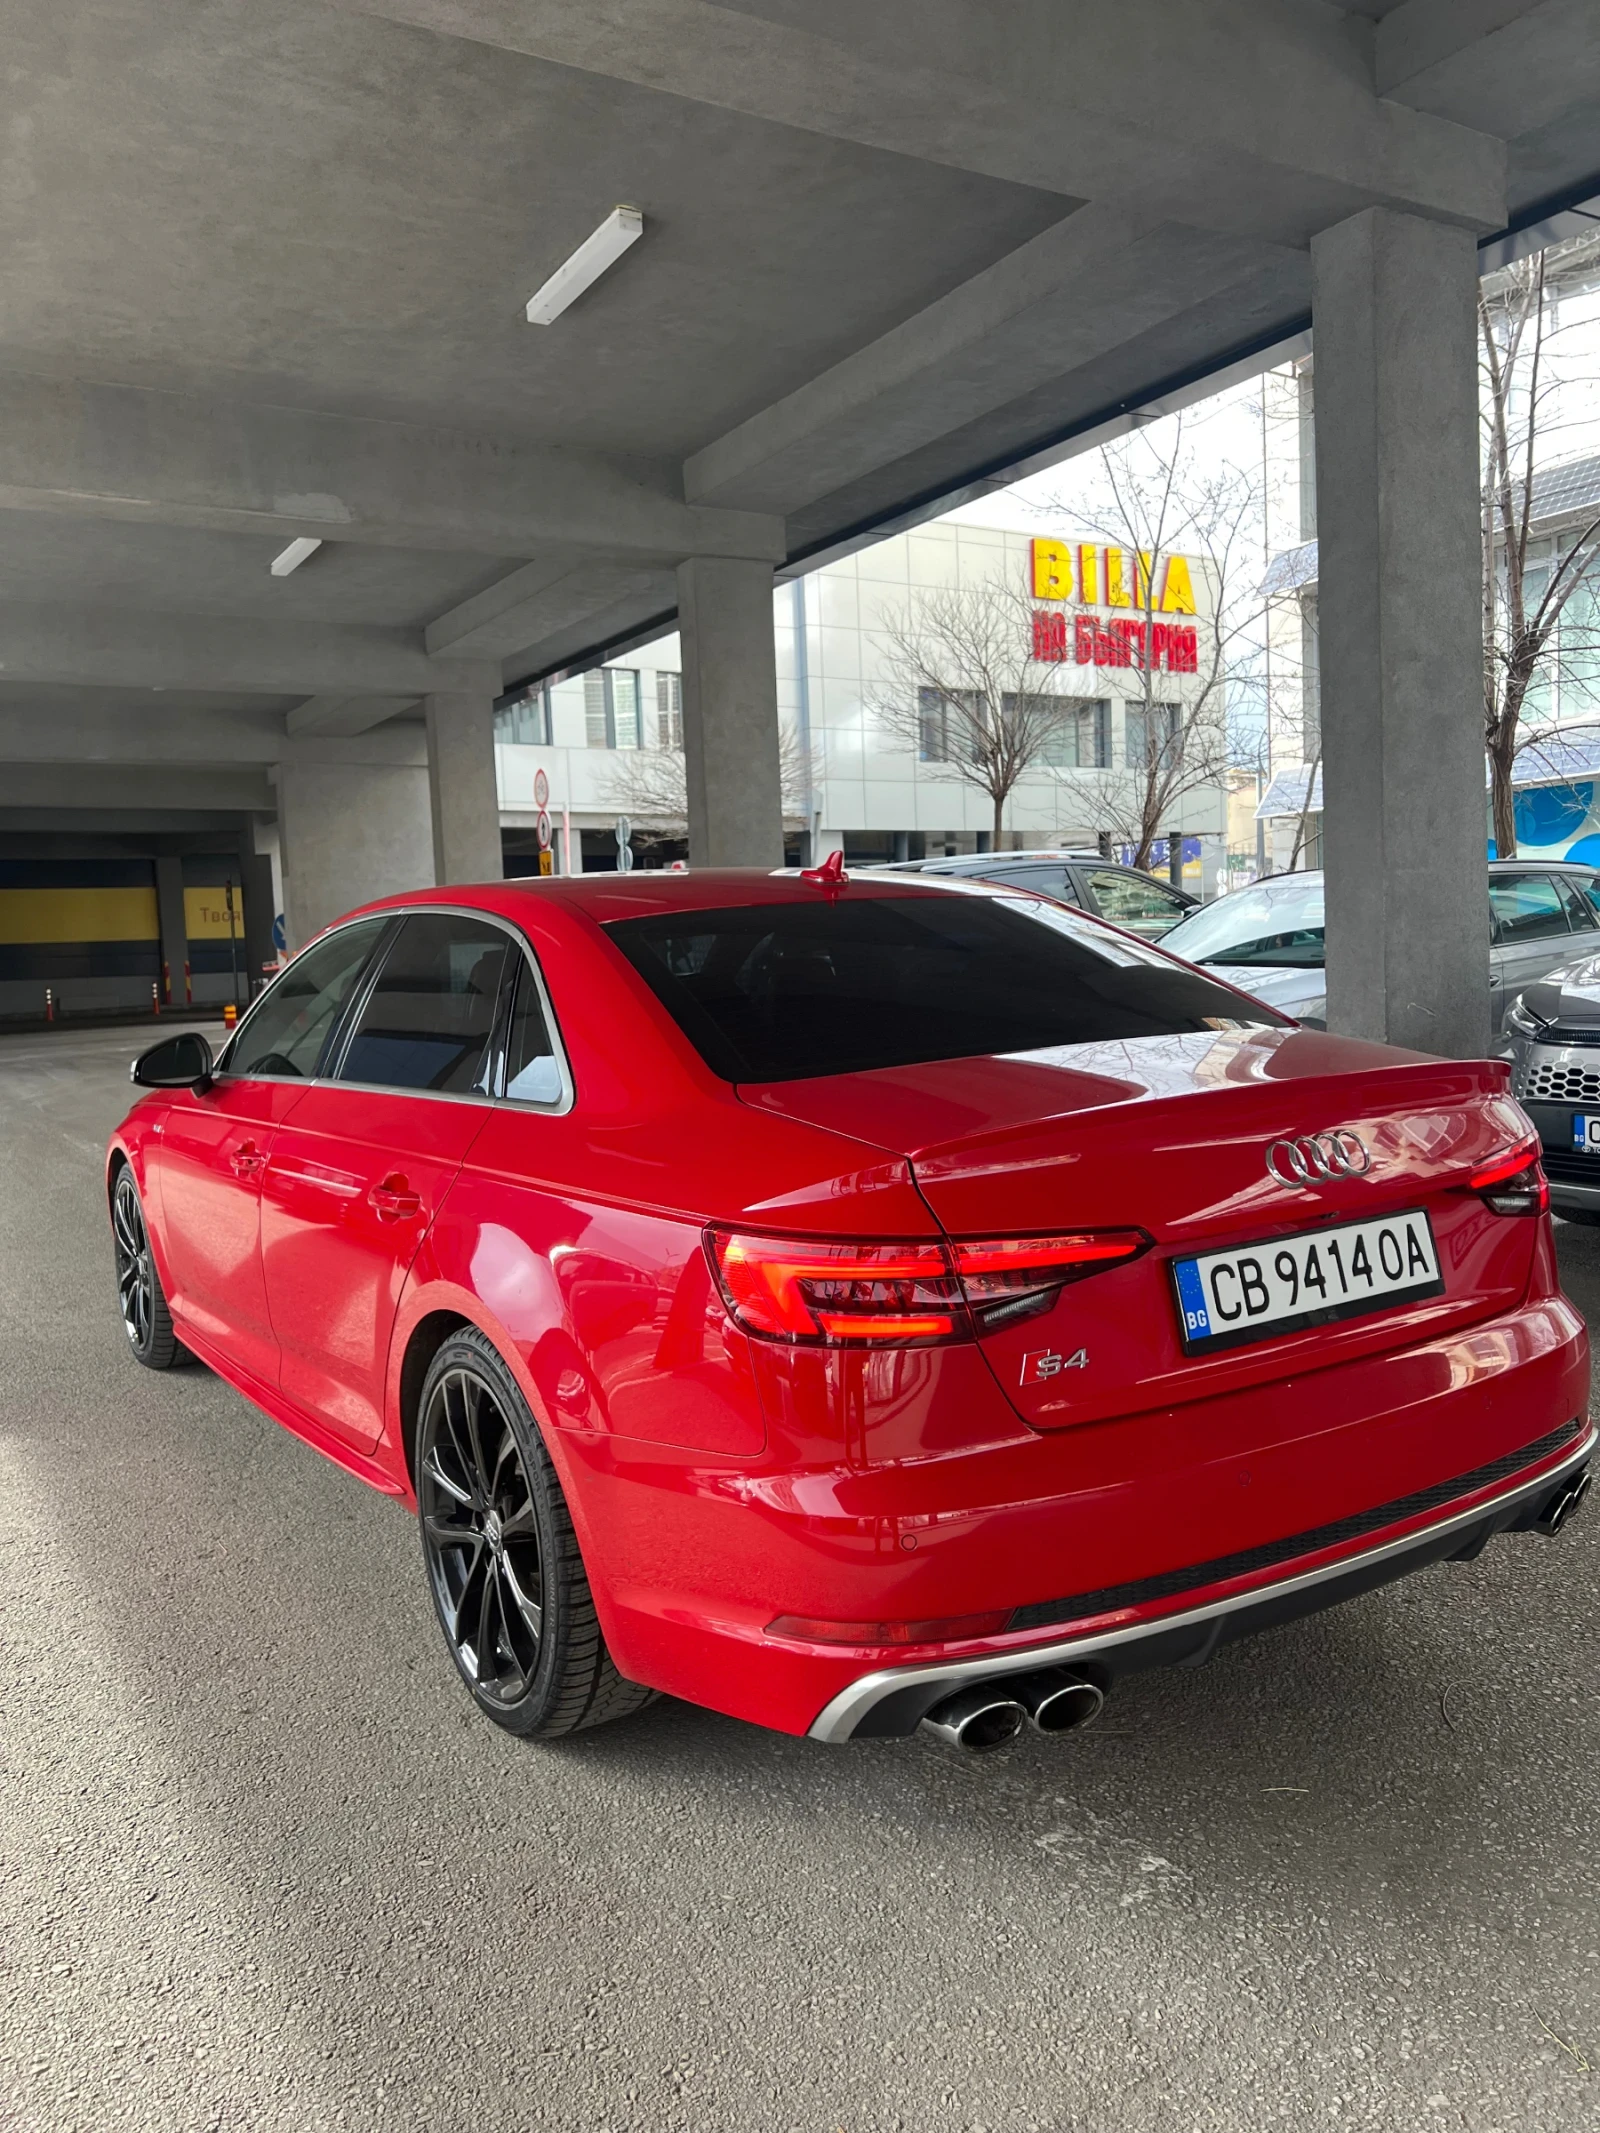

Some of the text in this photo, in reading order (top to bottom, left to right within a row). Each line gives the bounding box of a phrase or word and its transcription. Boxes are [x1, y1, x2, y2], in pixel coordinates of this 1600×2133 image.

[1030, 538, 1196, 615] BILLA
[1210, 1257, 1270, 1321] CB
[1274, 1233, 1373, 1306] 9414
[1186, 1309, 1208, 1330] BG
[1036, 1347, 1090, 1377] S4
